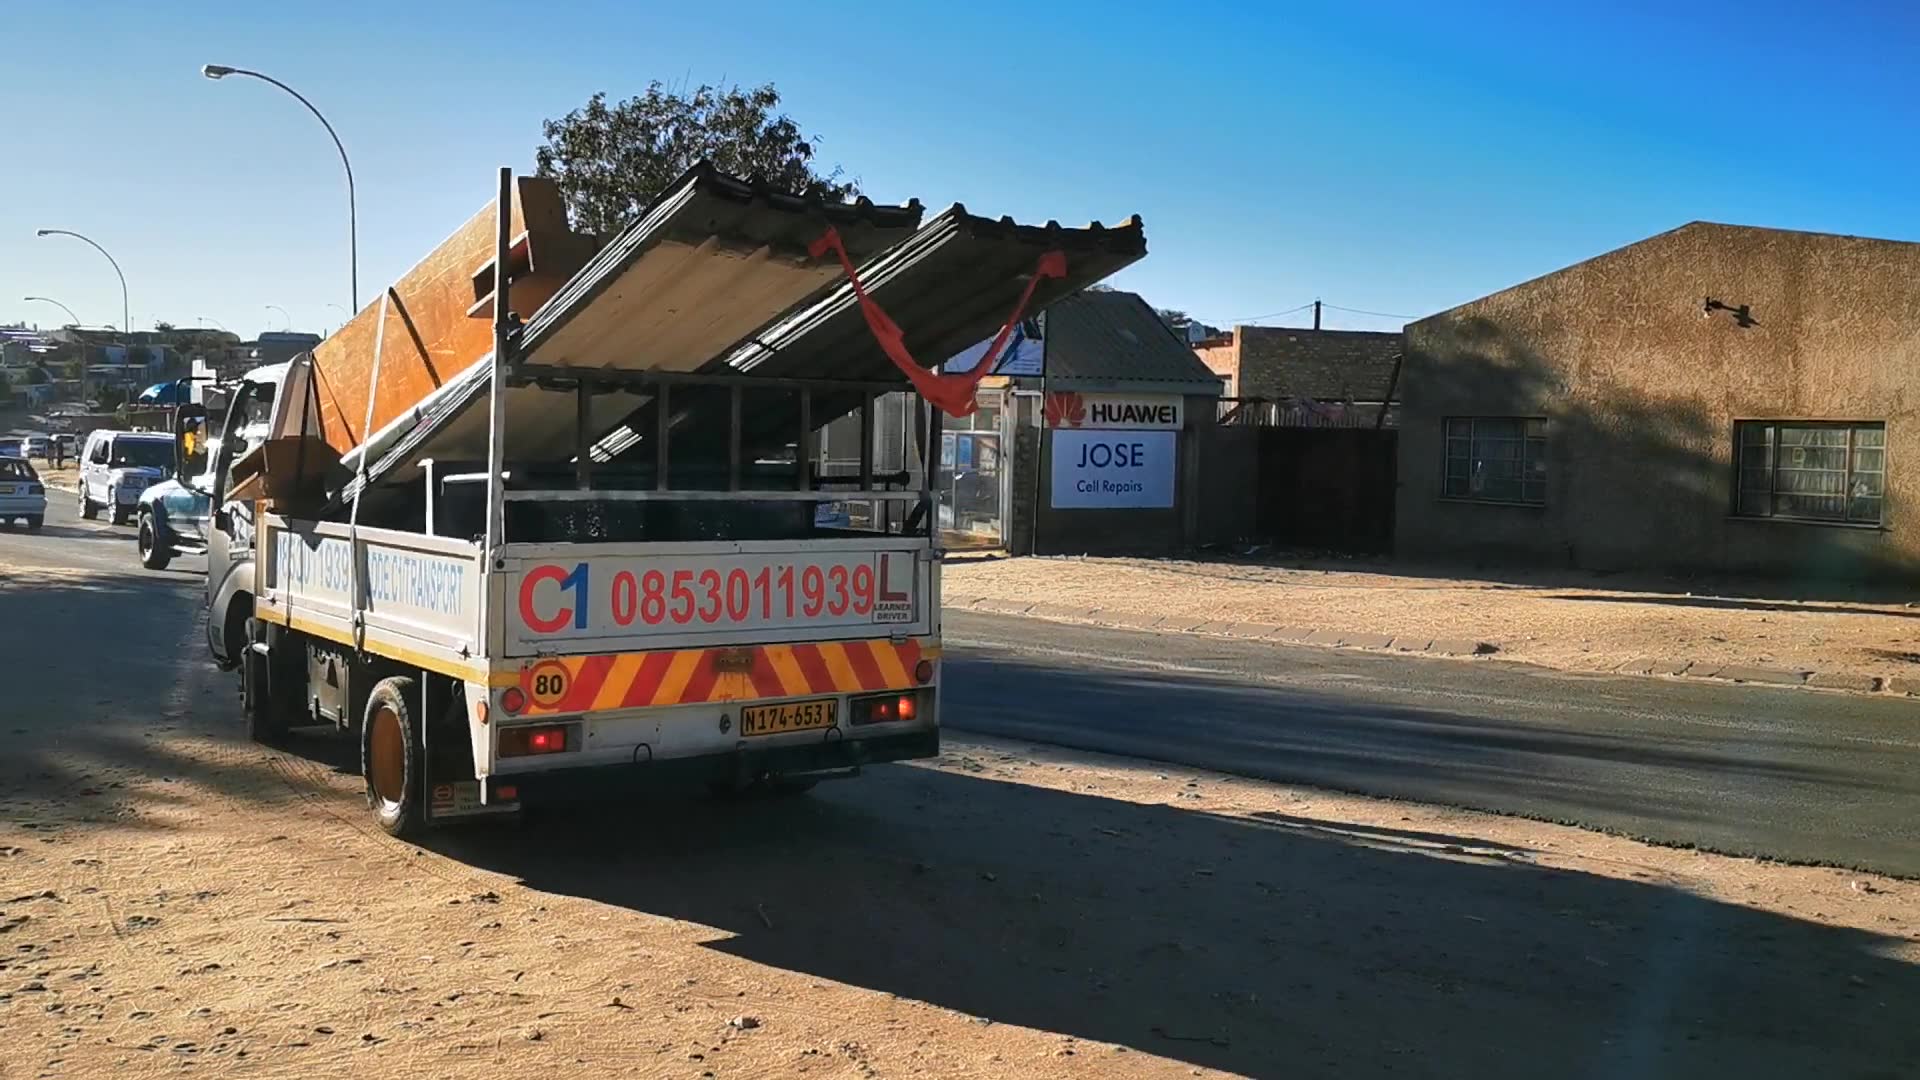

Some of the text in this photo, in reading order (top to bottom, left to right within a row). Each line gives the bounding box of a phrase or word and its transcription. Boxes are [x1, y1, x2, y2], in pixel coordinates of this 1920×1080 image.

[1091, 402, 1177, 424] HUAWEI
[1077, 443, 1144, 468] JOSE
[1076, 479, 1143, 496] Cell Repairs
[879, 554, 907, 601] L
[518, 562, 873, 633] C1 0853011939
[873, 603, 912, 611] LEARNER
[877, 612, 908, 620] DRIVER
[535, 674, 562, 695] 80
